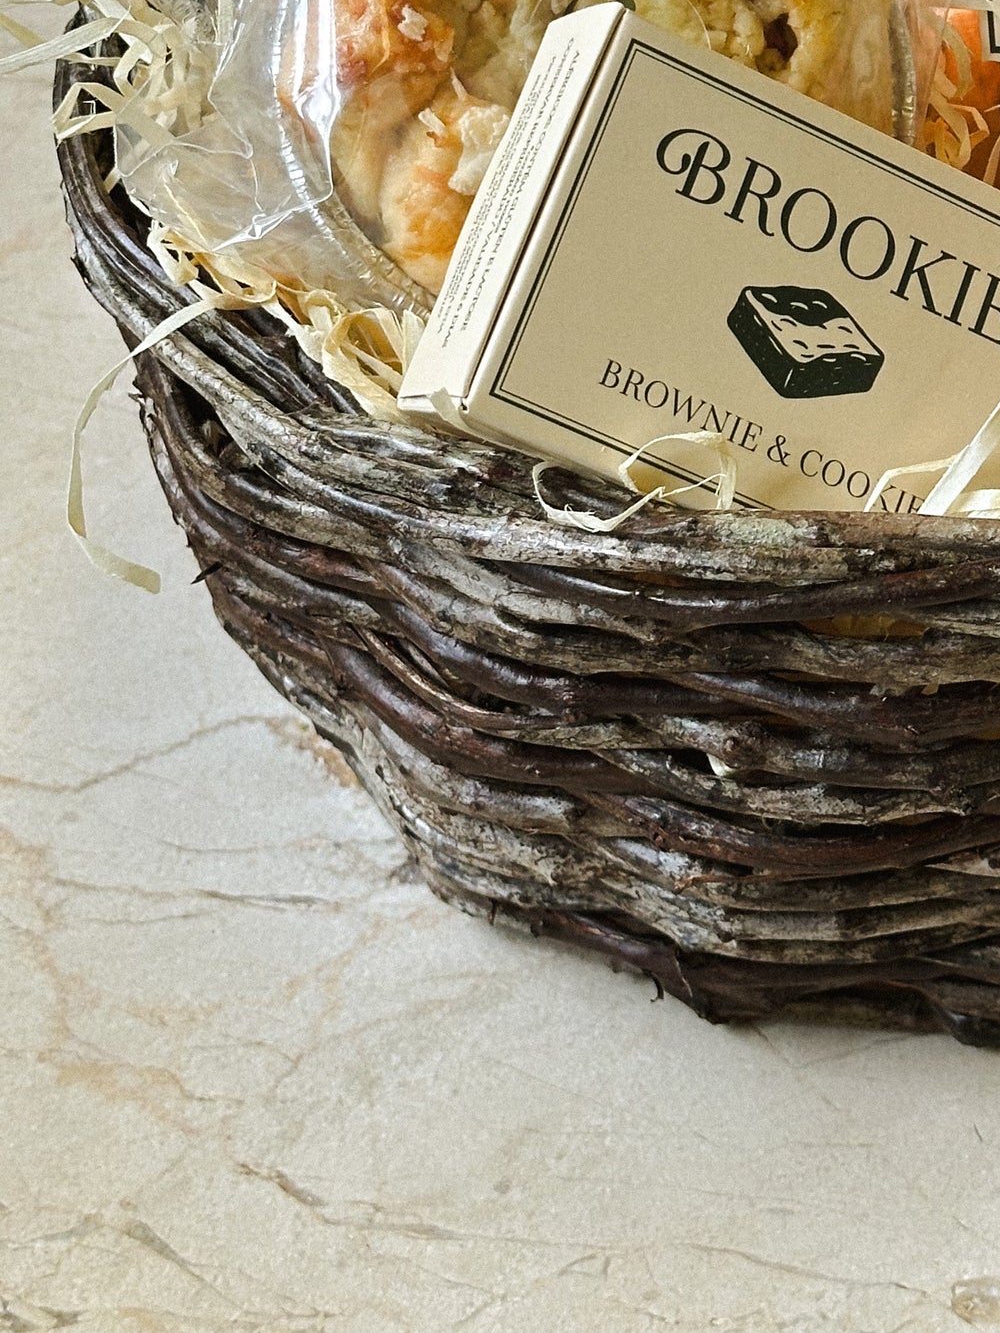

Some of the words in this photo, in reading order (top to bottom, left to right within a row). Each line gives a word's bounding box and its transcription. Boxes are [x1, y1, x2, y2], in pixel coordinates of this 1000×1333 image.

[460, 268, 491, 332] LACTOSE
[461, 230, 494, 301] VALIDADE
[597, 358, 762, 453] BROWNIE
[766, 433, 791, 467] &
